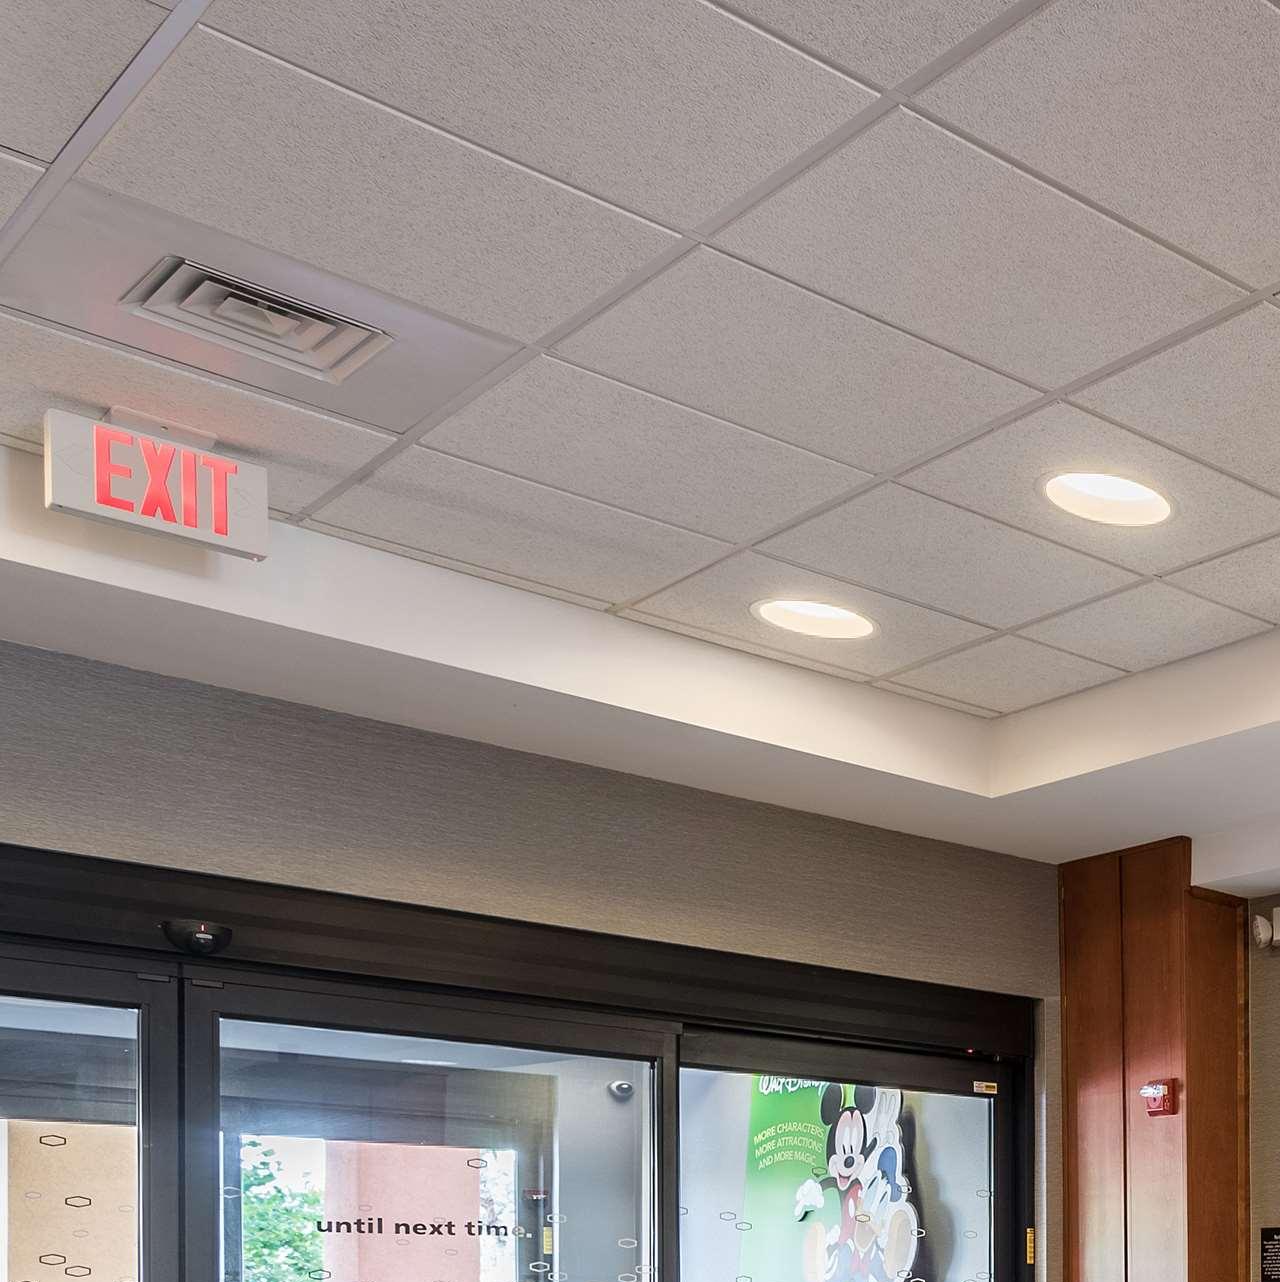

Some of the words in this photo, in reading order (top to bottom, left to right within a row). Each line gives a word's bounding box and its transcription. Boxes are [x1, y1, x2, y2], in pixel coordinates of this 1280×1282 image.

[93, 424, 237, 537] EXIT
[754, 1125, 776, 1145] MORE
[777, 1122, 824, 1138] CHARACTERS
[755, 1140, 777, 1158] MORE
[777, 1136, 823, 1153] ATTRACTIONS
[758, 1156, 774, 1170] AND
[774, 1150, 794, 1163] MORE
[316, 1217, 383, 1234] until
[394, 1220, 456, 1236] next
[464, 1220, 533, 1239] time.
